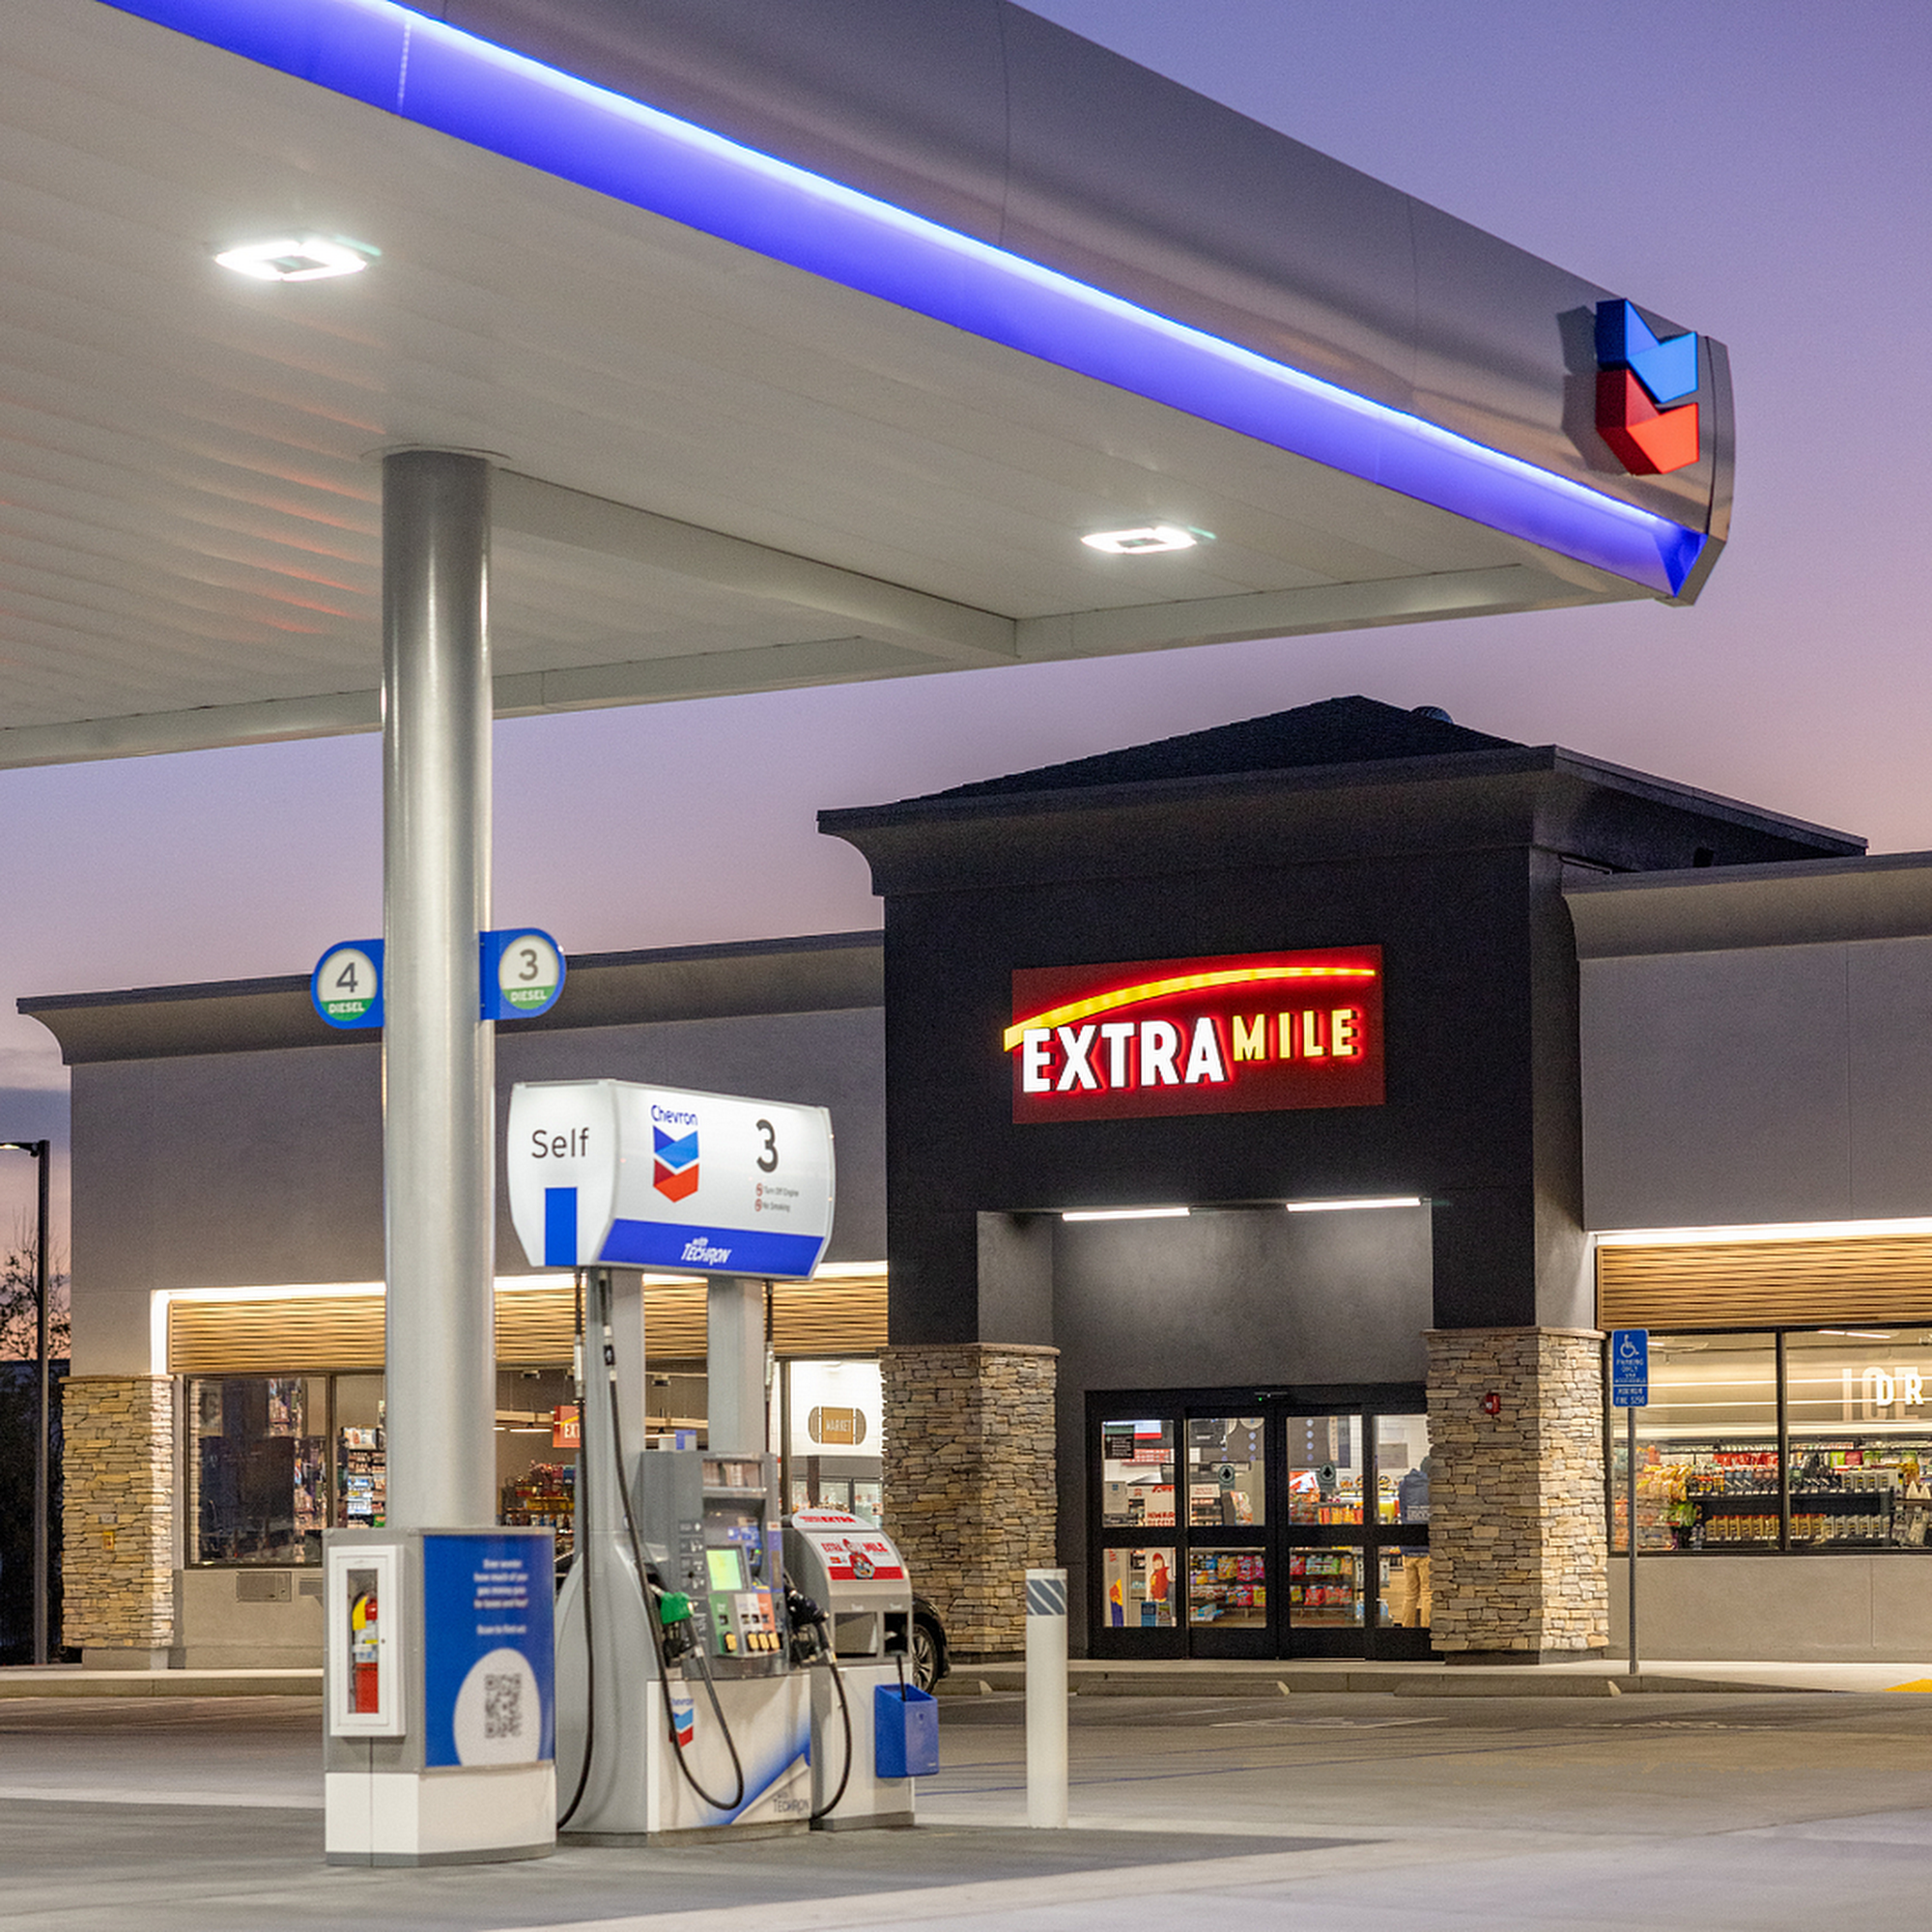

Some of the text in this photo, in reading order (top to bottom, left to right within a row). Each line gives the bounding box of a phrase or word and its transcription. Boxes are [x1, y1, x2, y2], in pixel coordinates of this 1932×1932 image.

[335, 962, 358, 993] 4
[518, 949, 538, 980] 3
[328, 1002, 365, 1014] DIESEL
[510, 989, 548, 1003] DIESEL
[1022, 1009, 1353, 1093] EXTRA MILE
[650, 1104, 698, 1126] Chevron
[531, 1127, 590, 1158] Self
[755, 1119, 779, 1173] 3
[826, 1418, 851, 1432] MARKET
